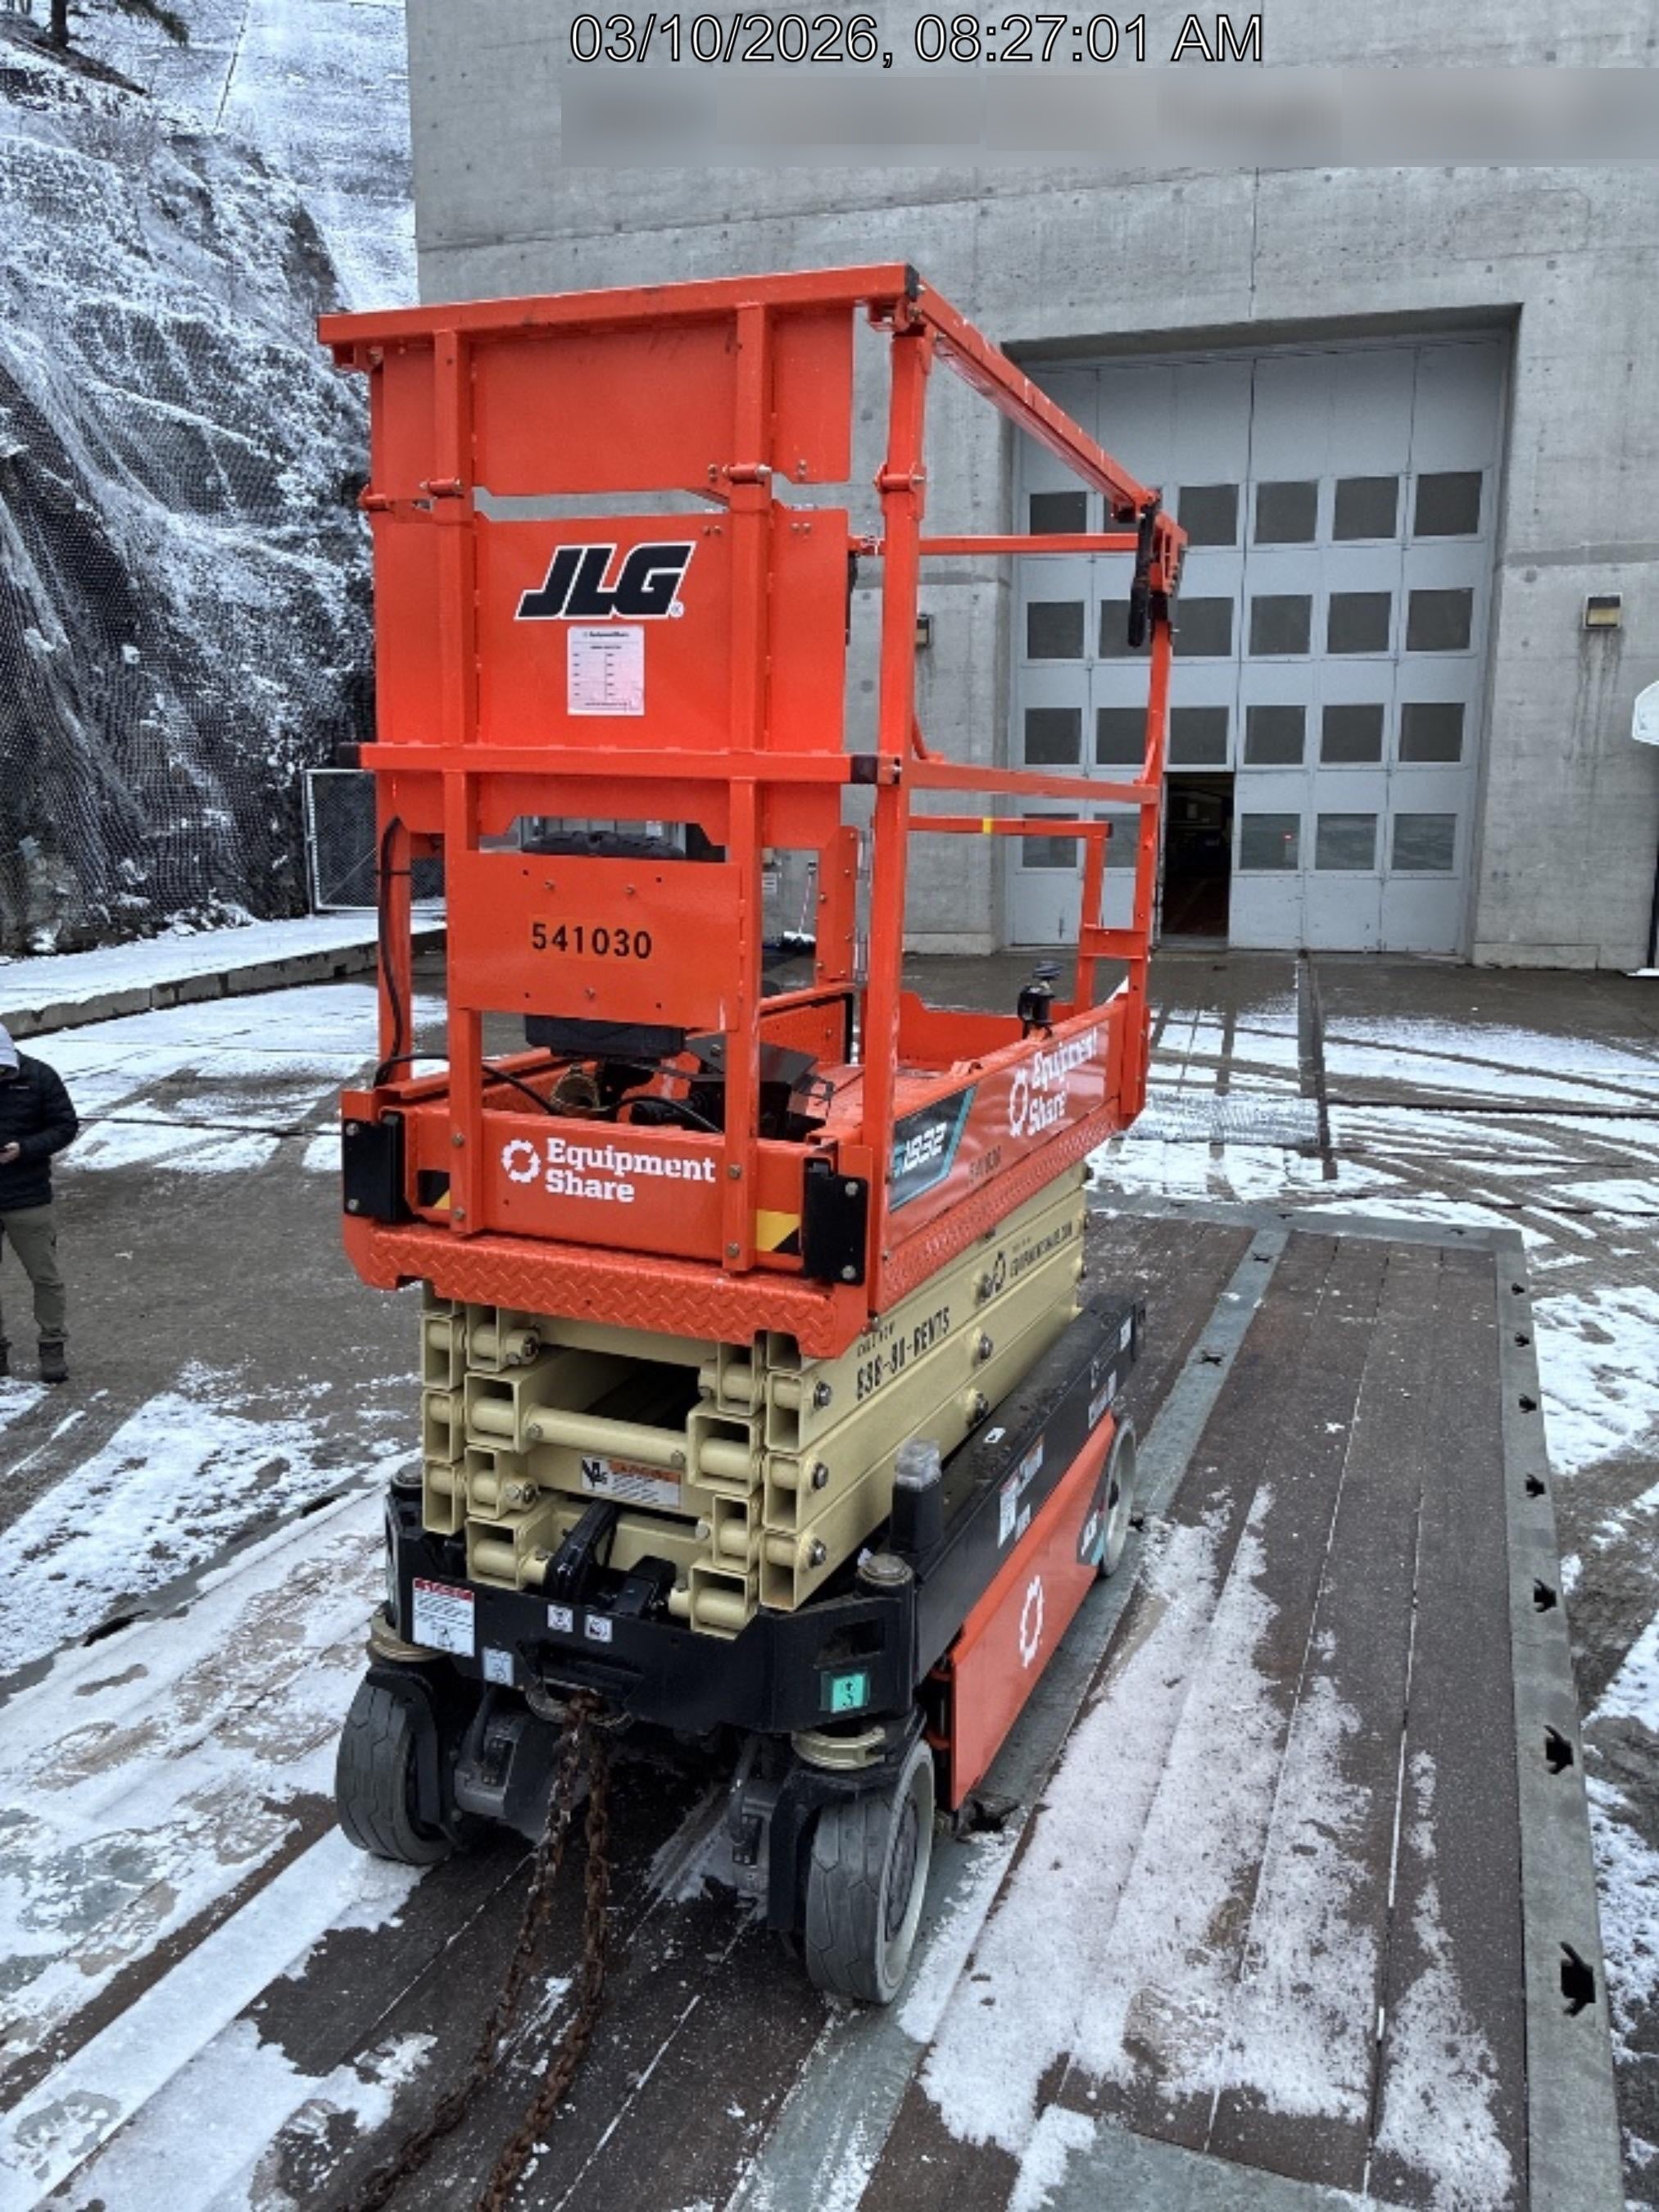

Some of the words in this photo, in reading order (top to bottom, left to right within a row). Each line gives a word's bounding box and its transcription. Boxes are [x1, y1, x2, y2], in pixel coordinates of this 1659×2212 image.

[514, 542, 696, 620] JLG
[532, 922, 652, 959] 541030
[546, 1137, 716, 1183] Equipment
[545, 1168, 635, 1203] Share
